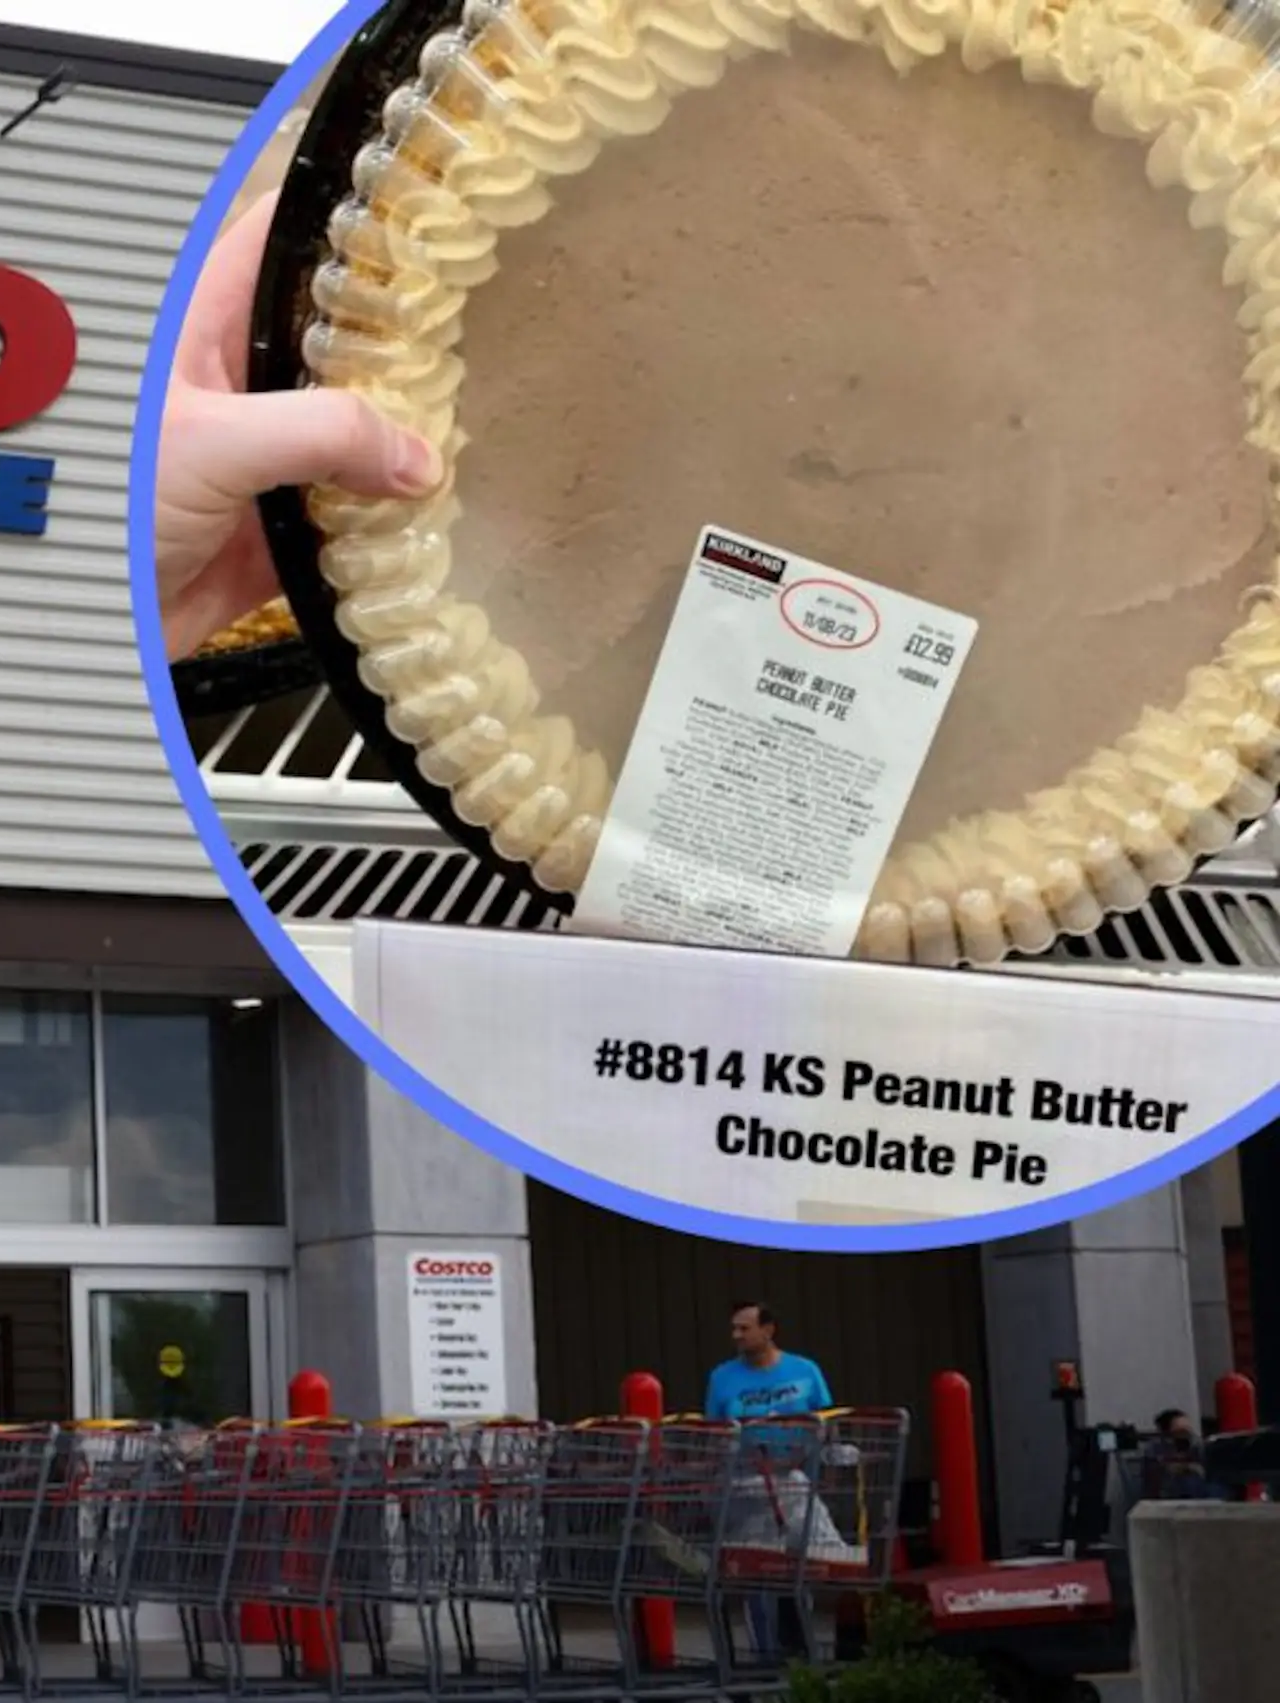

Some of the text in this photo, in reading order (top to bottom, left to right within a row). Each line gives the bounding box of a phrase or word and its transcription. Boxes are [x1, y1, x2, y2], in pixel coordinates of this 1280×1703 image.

[707, 537, 783, 574] KIRKLAND
[755, 677, 850, 721] CHOCOLATE PIE
[762, 659, 857, 703] PEANUT BUTTER
[594, 1038, 1188, 1133] #8814 KS Peanut Butter
[716, 1114, 1048, 1186] Chocolate Pie
[414, 1259, 493, 1276] COSTCO
